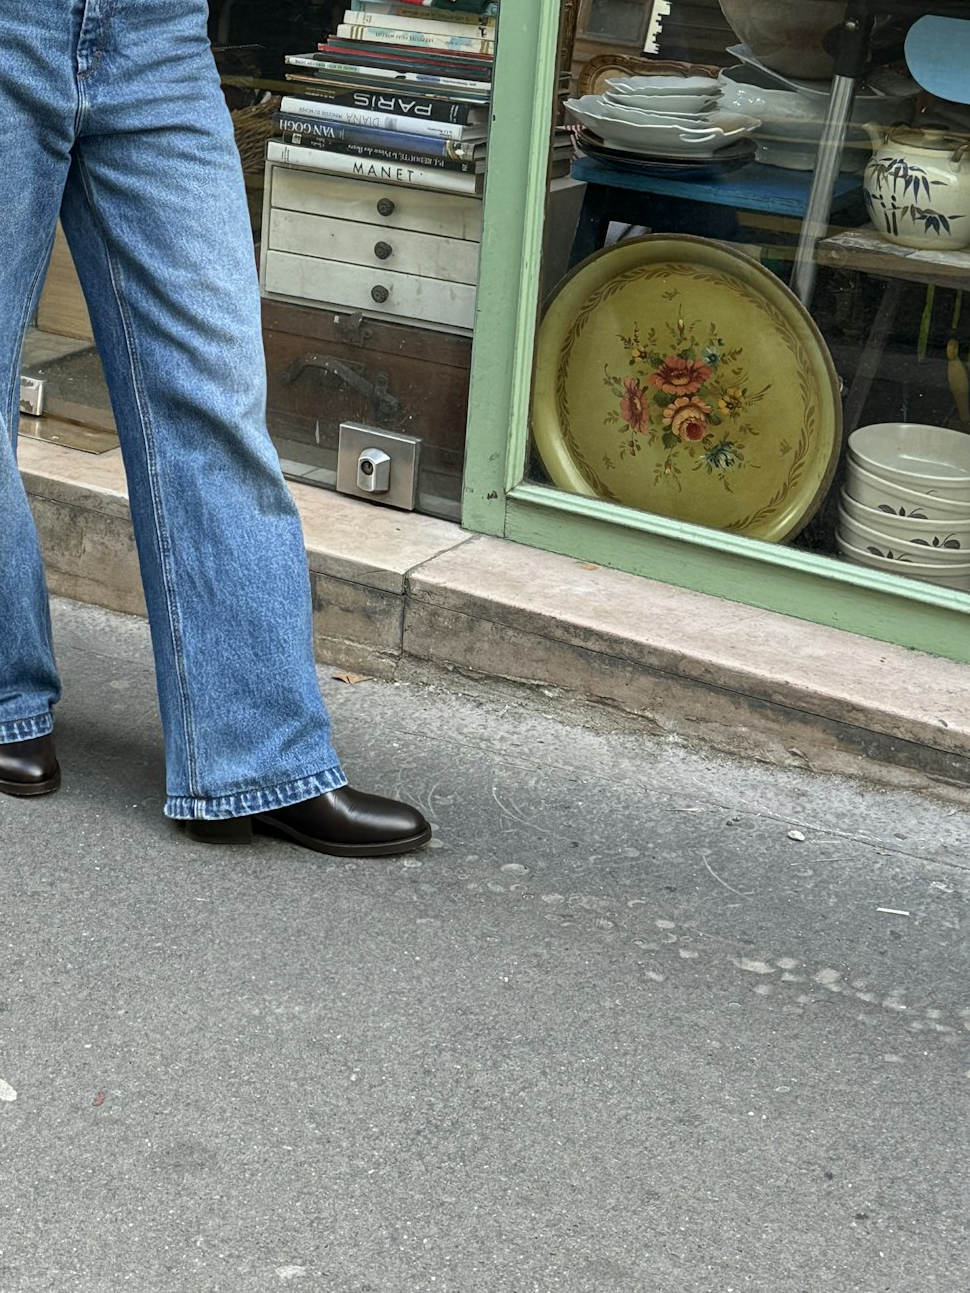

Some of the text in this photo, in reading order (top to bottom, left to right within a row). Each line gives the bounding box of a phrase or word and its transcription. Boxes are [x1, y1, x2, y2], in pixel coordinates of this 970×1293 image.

[279, 119, 336, 138] VAN GOGH
[346, 113, 380, 127] DIANA
[352, 162, 415, 183] MANET
